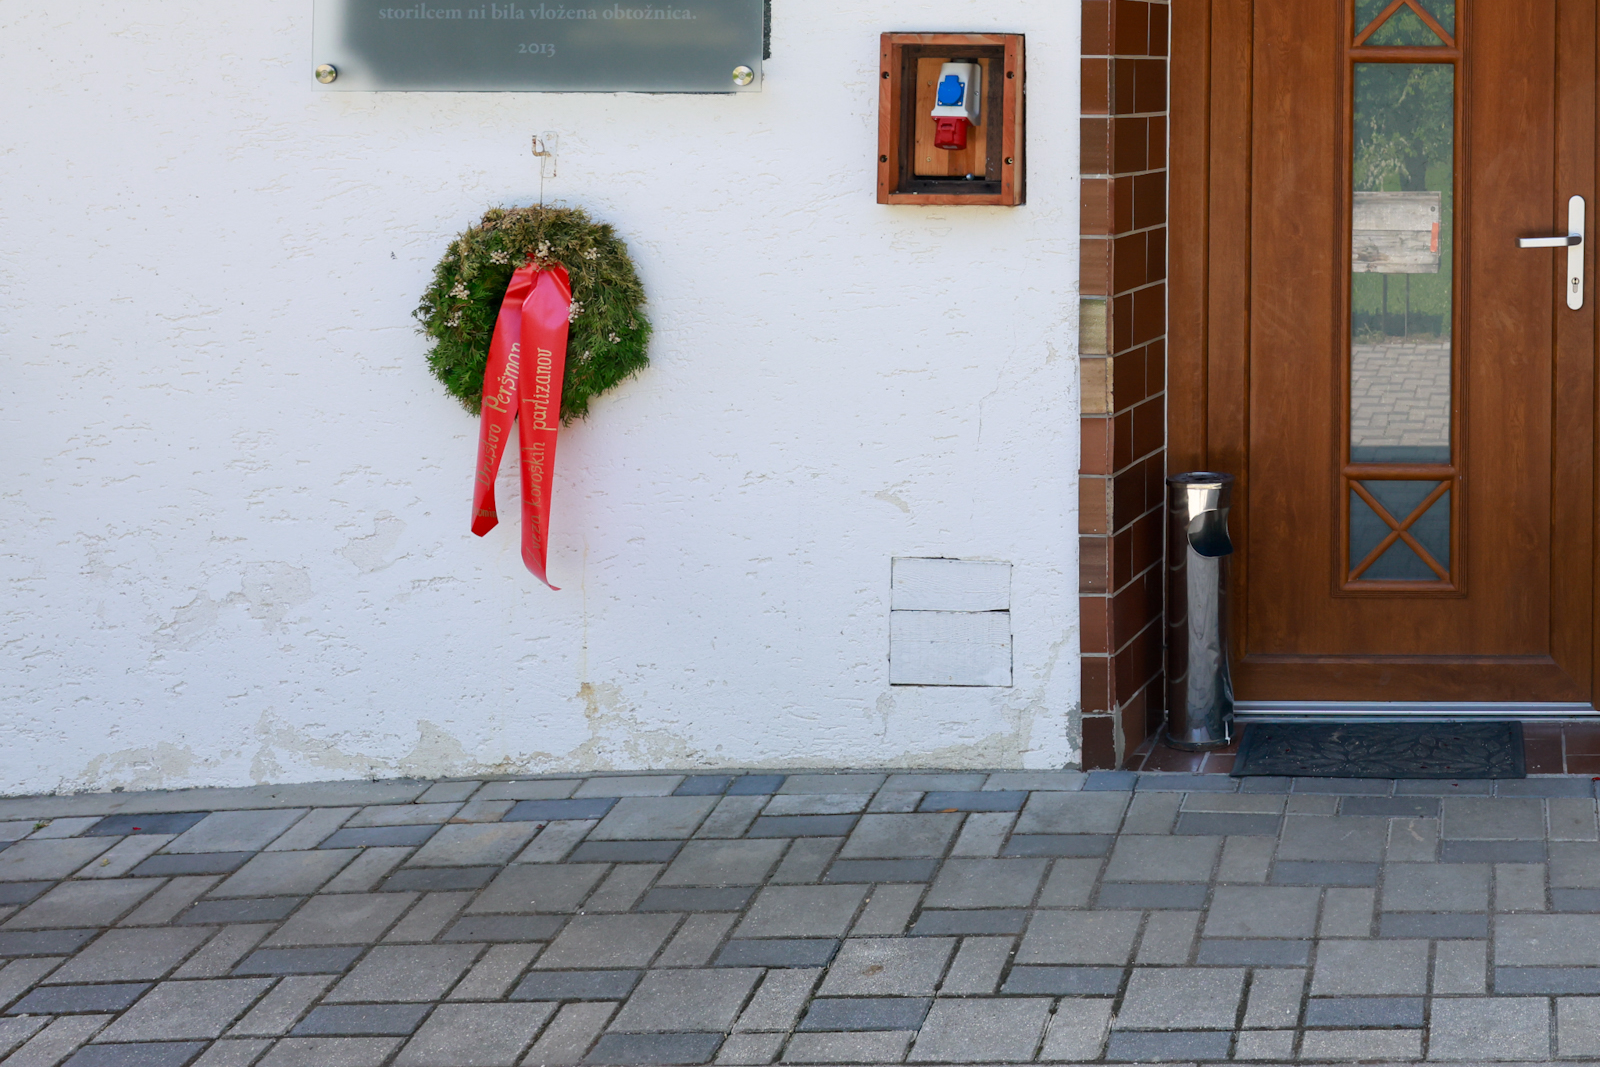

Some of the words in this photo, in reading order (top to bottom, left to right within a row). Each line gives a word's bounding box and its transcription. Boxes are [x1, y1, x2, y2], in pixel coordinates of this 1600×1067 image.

[379, 2, 462, 20] storilcem
[468, 2, 485, 20] ni
[491, 2, 525, 20] bila
[530, 2, 598, 20] vložena
[602, 2, 697, 20] obtožnica.
[518, 43, 556, 59] 2013
[485, 342, 521, 414] Peršman
[522, 347, 557, 432] partizanov
[475, 423, 503, 491] Društvo
[520, 442, 546, 509] koroških
[525, 513, 544, 570] Zveza
